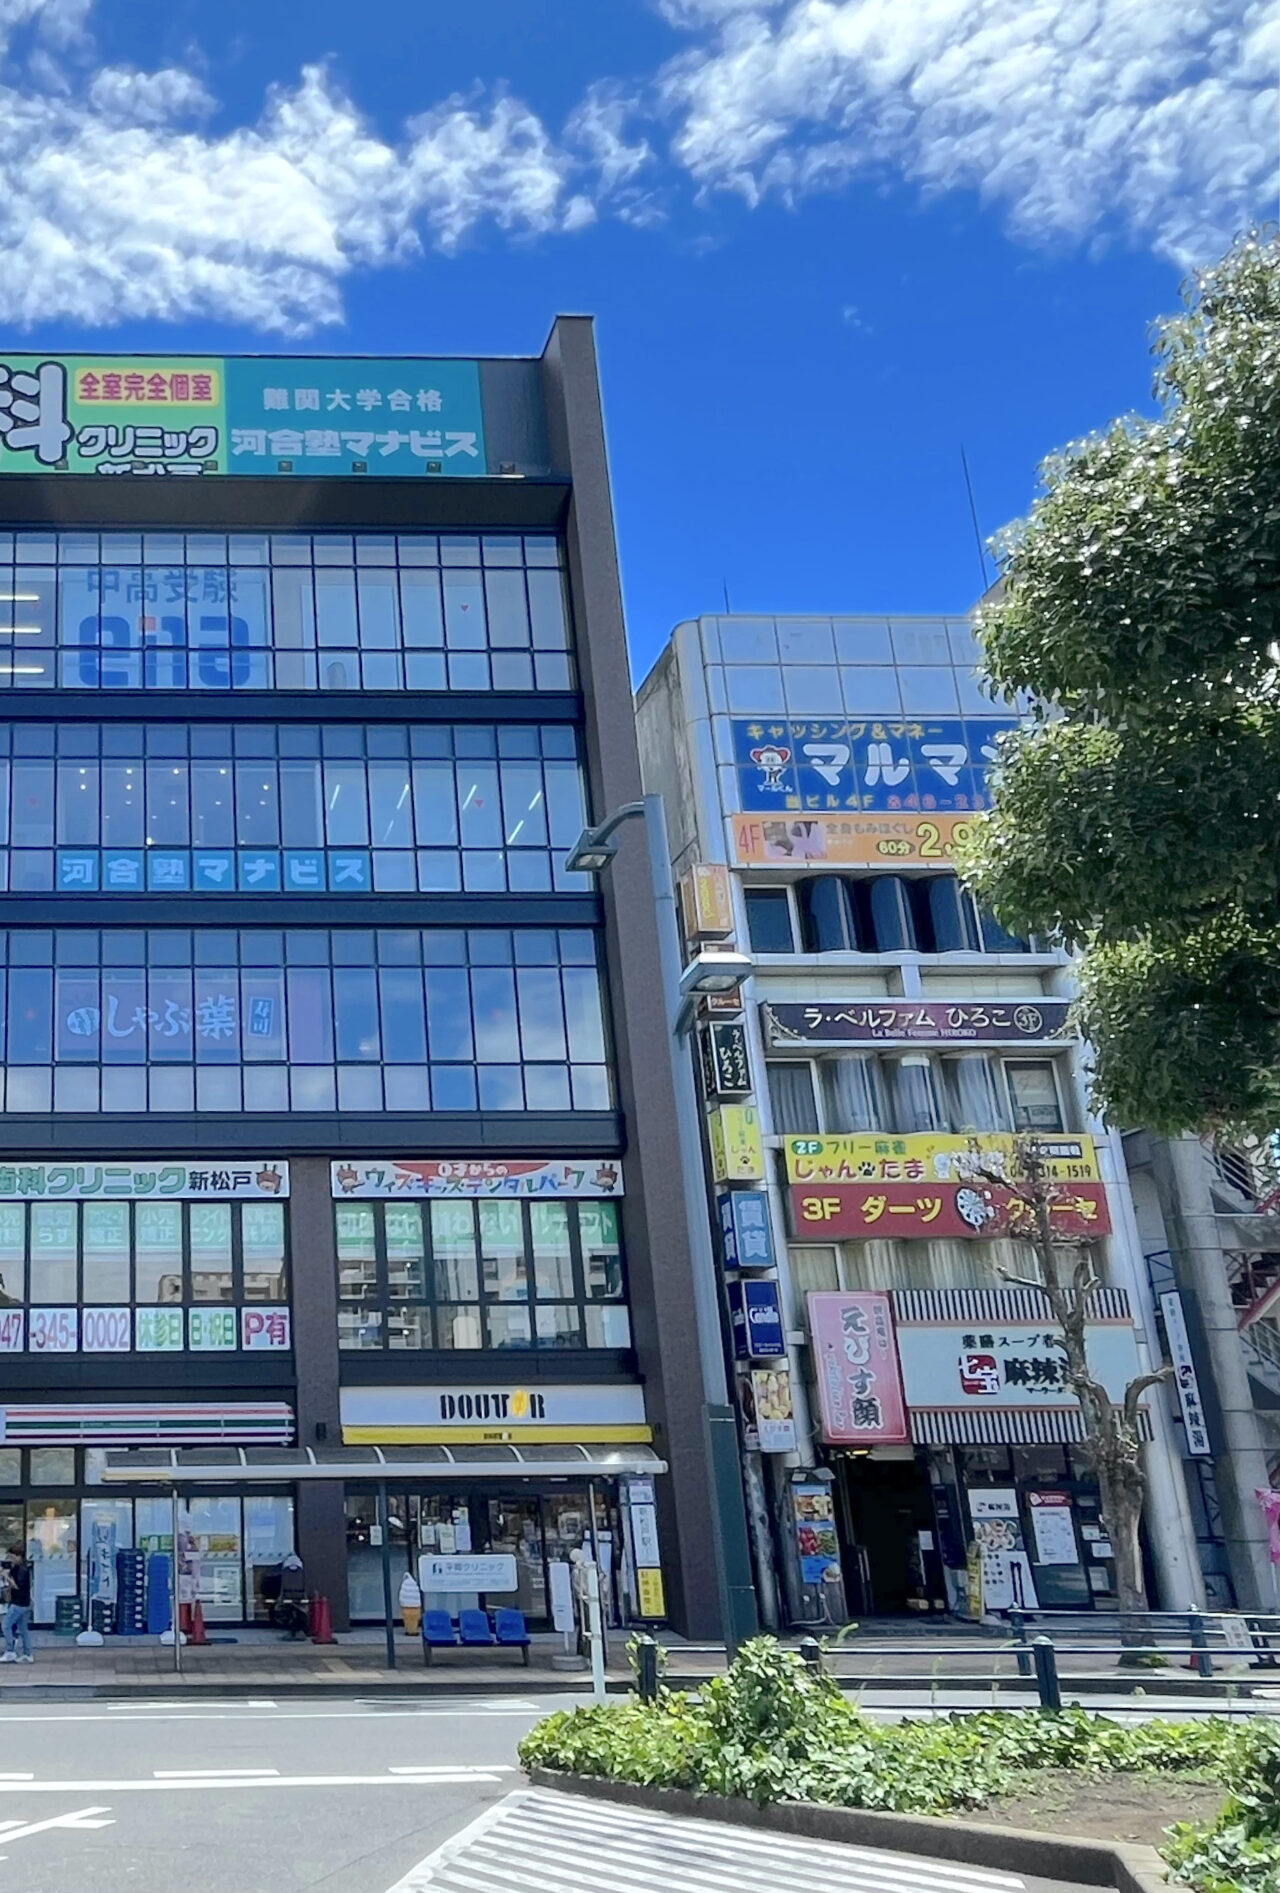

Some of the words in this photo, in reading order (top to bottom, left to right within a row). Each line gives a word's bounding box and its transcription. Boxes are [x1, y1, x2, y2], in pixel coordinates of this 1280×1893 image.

[78, 371, 212, 402] 全室完全個室
[263, 387, 443, 412] 難関大学合格
[76, 426, 218, 459] クリニック
[231, 428, 479, 458] 河合塾マナビス
[78, 615, 251, 687] ena
[738, 824, 762, 847] 4F
[62, 857, 364, 884] 河合塾マナビス
[106, 994, 237, 1040] しゃぶ葉
[946, 1007, 1011, 1028] ひろこ
[719, 1046, 735, 1087] ひろこ
[794, 1141, 819, 1154] 2F
[189, 1169, 253, 1192] 新松戸
[794, 1158, 858, 1180] じゃん
[878, 1158, 925, 1178] たま
[801, 1197, 842, 1221] 3F
[860, 1195, 942, 1223] ダーツ
[84, 1311, 129, 1348] 0002
[139, 1311, 182, 1347] 休診日
[440, 1388, 546, 1419] DOUTOR
